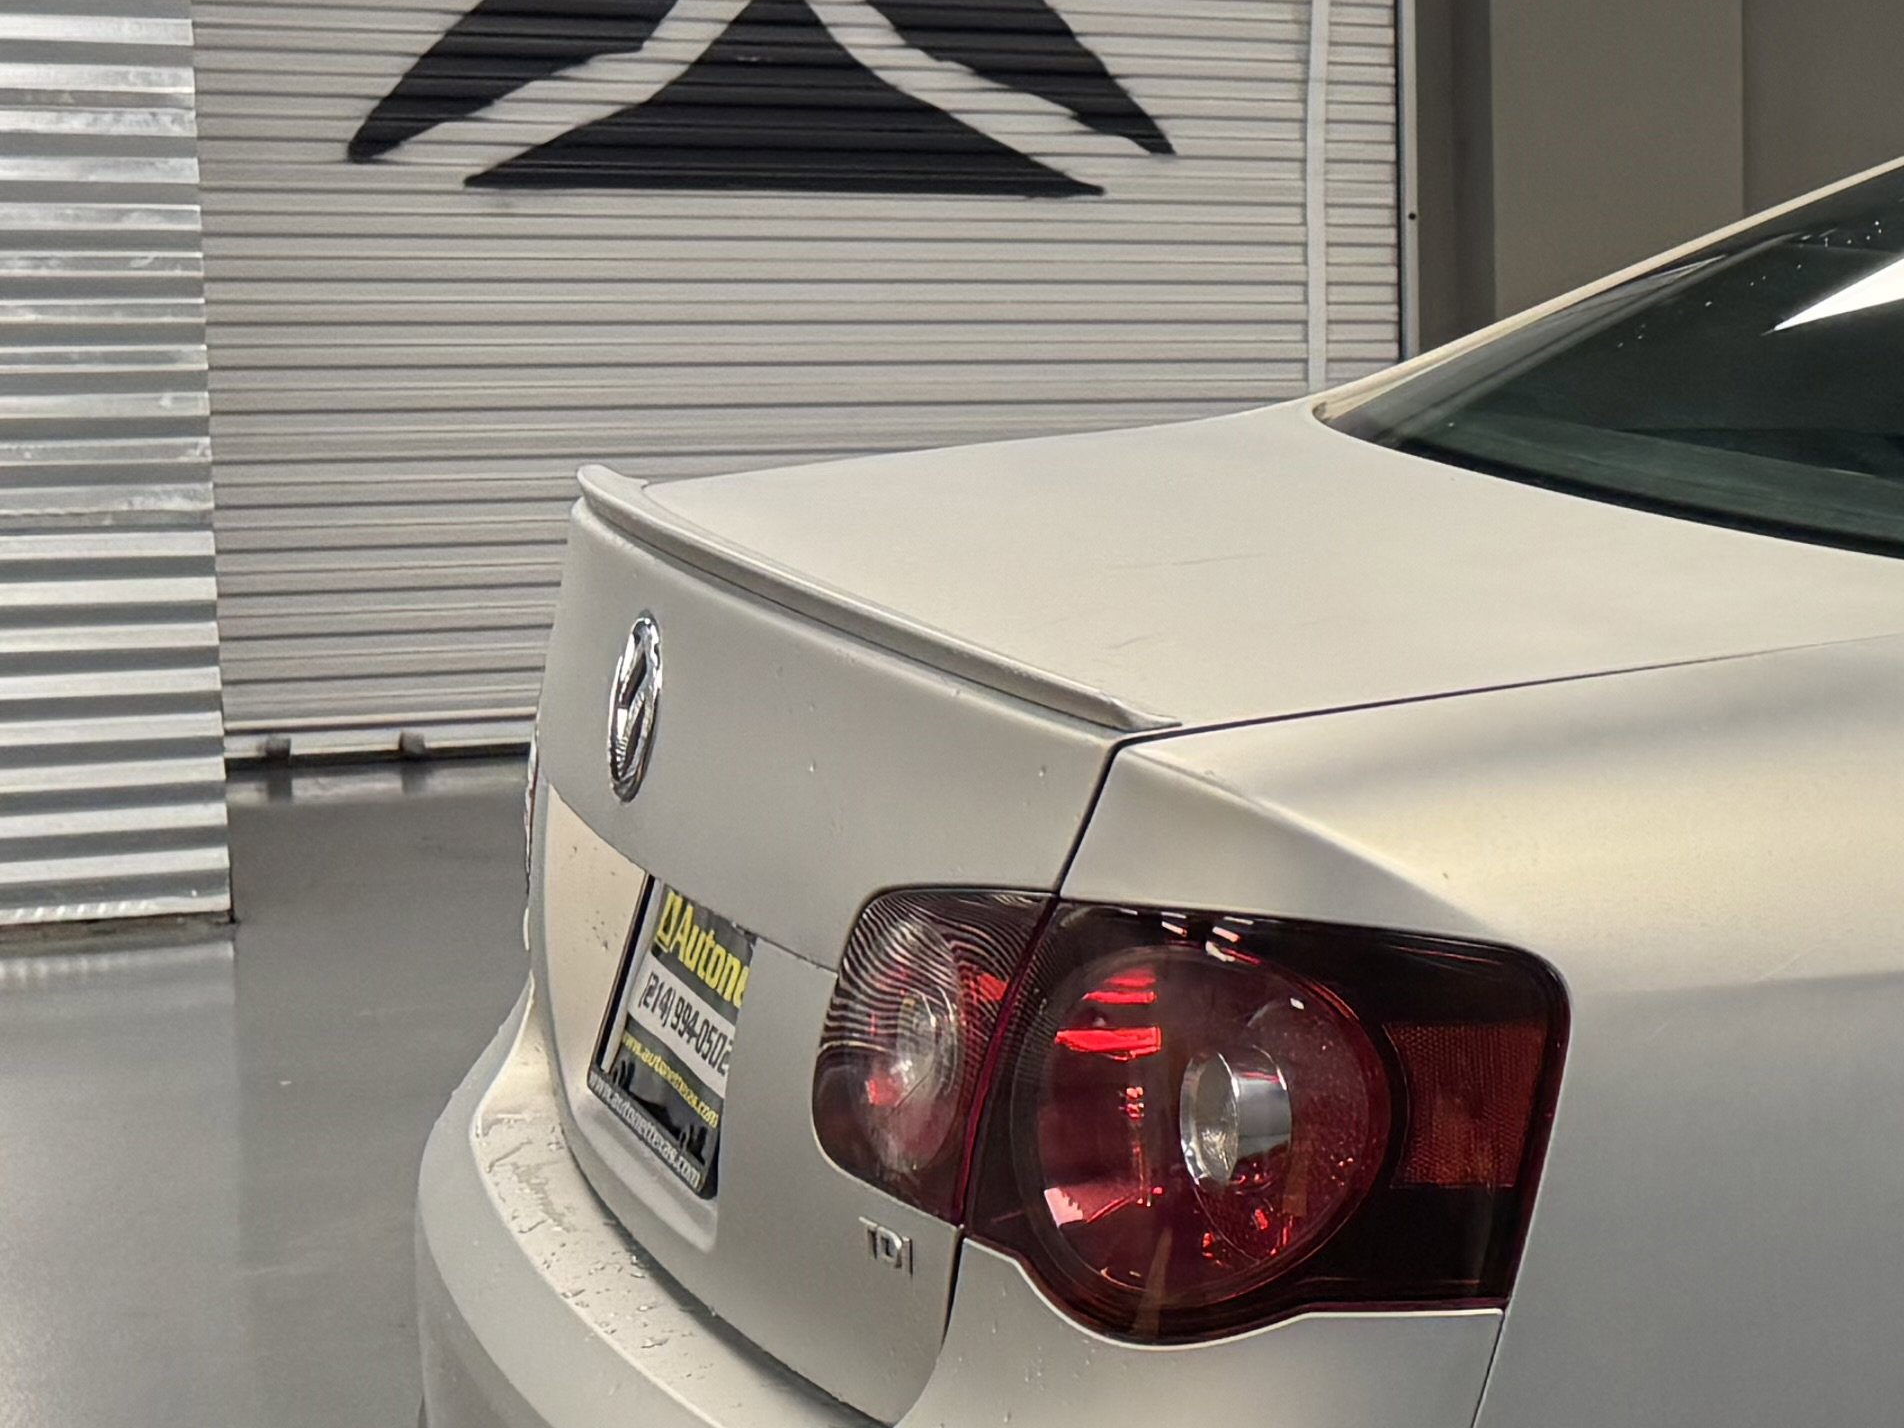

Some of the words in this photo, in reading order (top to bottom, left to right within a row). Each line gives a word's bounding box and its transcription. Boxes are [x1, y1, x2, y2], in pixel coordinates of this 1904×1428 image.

[638, 972, 677, 1028] (214)
[588, 1072, 701, 1189] www.autonettexas.com
[859, 1216, 914, 1277] TDI
